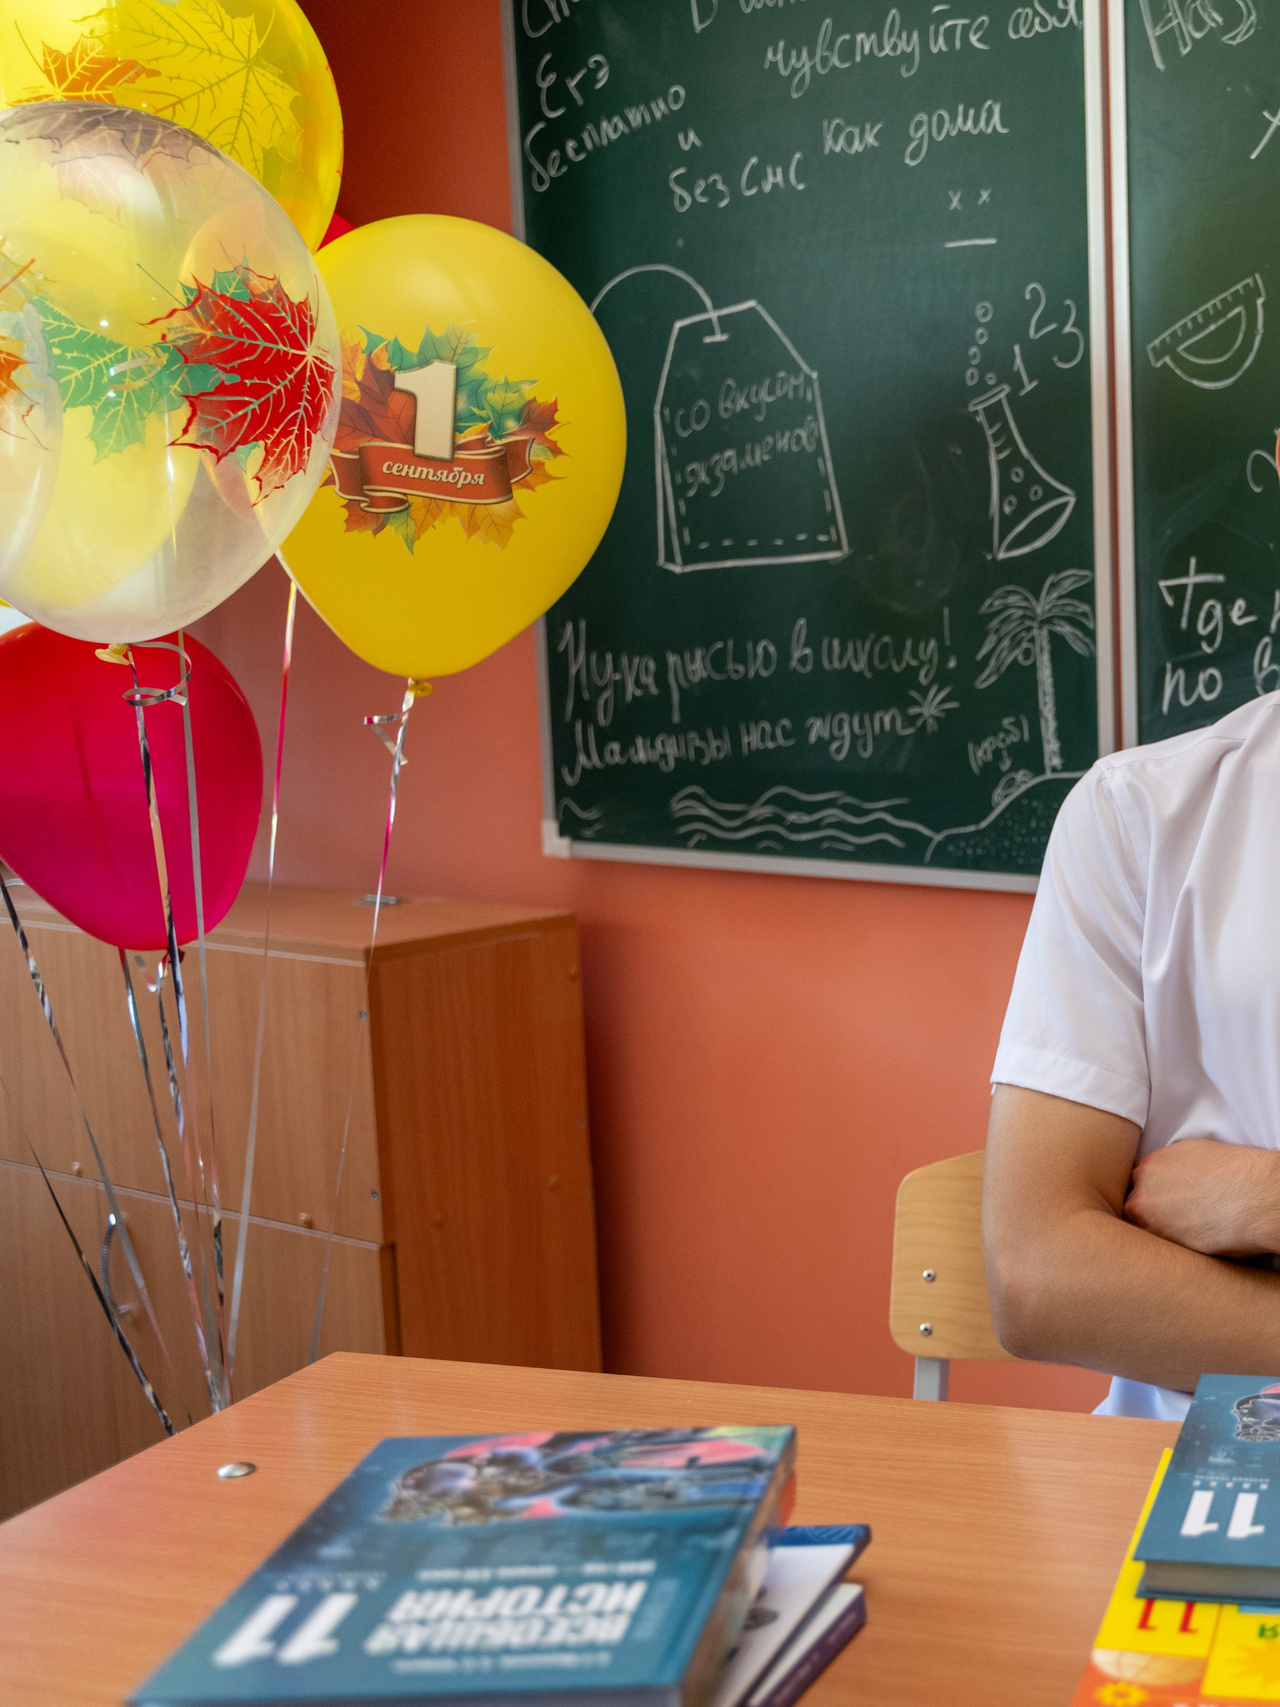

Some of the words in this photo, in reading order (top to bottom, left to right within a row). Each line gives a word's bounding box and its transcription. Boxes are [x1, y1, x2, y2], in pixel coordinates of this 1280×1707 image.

[764, 4, 991, 99] чувствуйте
[524, 84, 687, 193] бесплатно
[677, 128, 703, 151] и
[904, 99, 1011, 167] дома
[668, 165, 731, 213] без
[394, 359, 458, 463] 1
[382, 460, 486, 489] сентября
[1161, 660, 1224, 716] по
[738, 717, 797, 757] нас
[1180, 1489, 1266, 1539] 11
[386, 1580, 650, 1622] ИСТОРИЯ
[212, 1592, 359, 1667] 11
